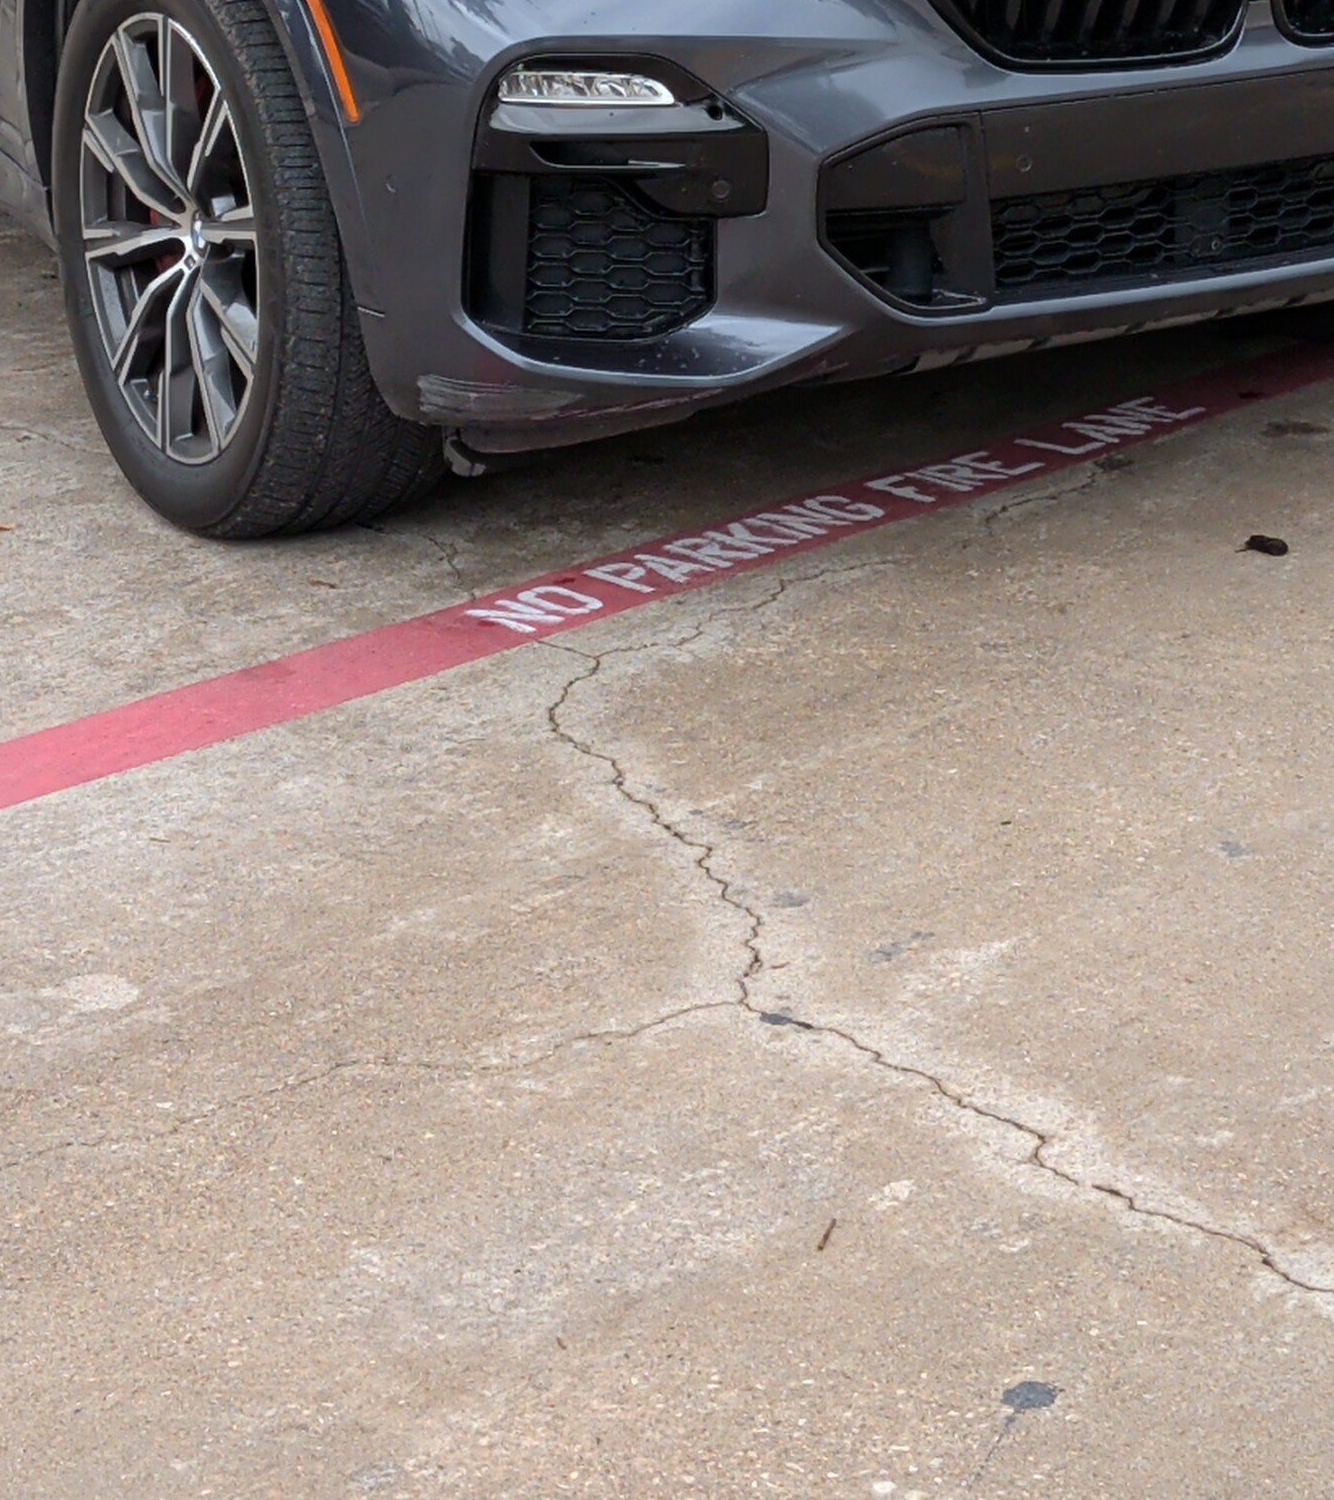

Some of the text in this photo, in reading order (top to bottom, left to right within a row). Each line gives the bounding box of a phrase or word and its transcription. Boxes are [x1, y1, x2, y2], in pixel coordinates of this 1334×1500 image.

[465, 396, 1206, 633] NO PARKING FIRE LANE
